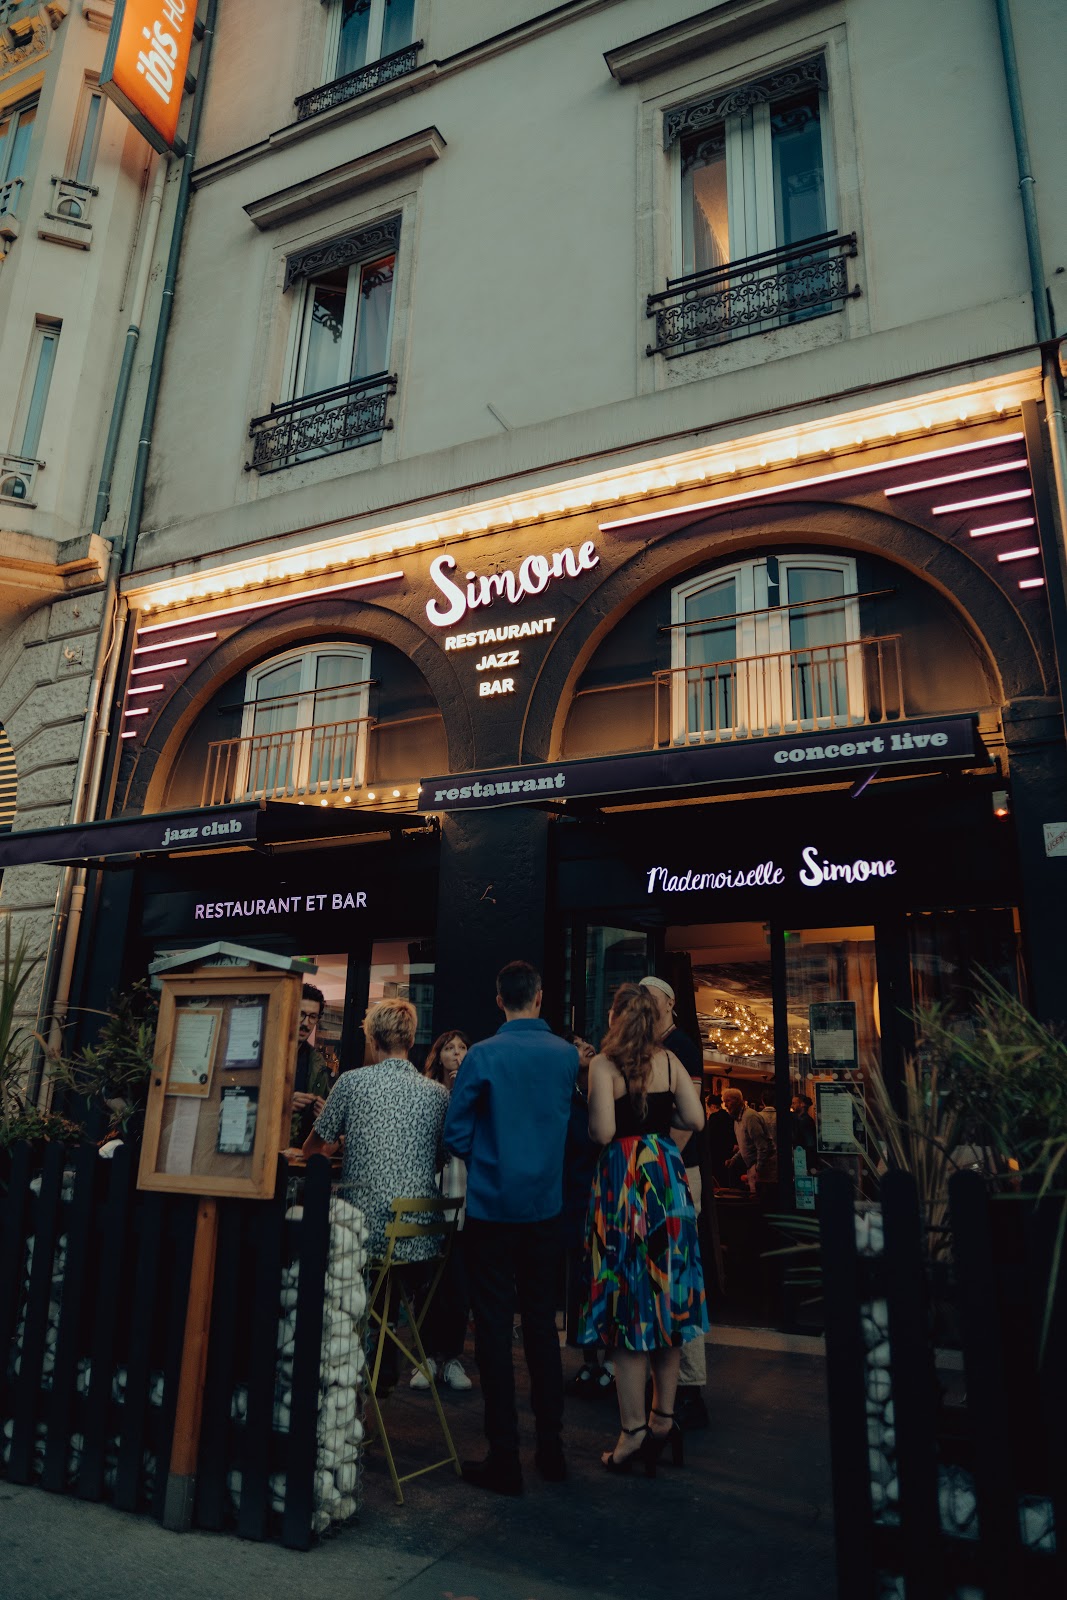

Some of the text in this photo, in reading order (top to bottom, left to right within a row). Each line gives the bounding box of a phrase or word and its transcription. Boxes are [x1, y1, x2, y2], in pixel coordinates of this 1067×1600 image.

[136, 20, 178, 104] ibis
[425, 540, 599, 627] Simone
[445, 617, 556, 650] RESTAURANT
[476, 650, 519, 670] JAZZ
[479, 678, 514, 697] BAR
[773, 732, 948, 764] concert live
[434, 772, 566, 802] restaurant
[161, 819, 242, 846] jazz club
[647, 847, 897, 893] Mademoiselle Simone
[194, 891, 367, 920] RESTAURANT ET BAR
